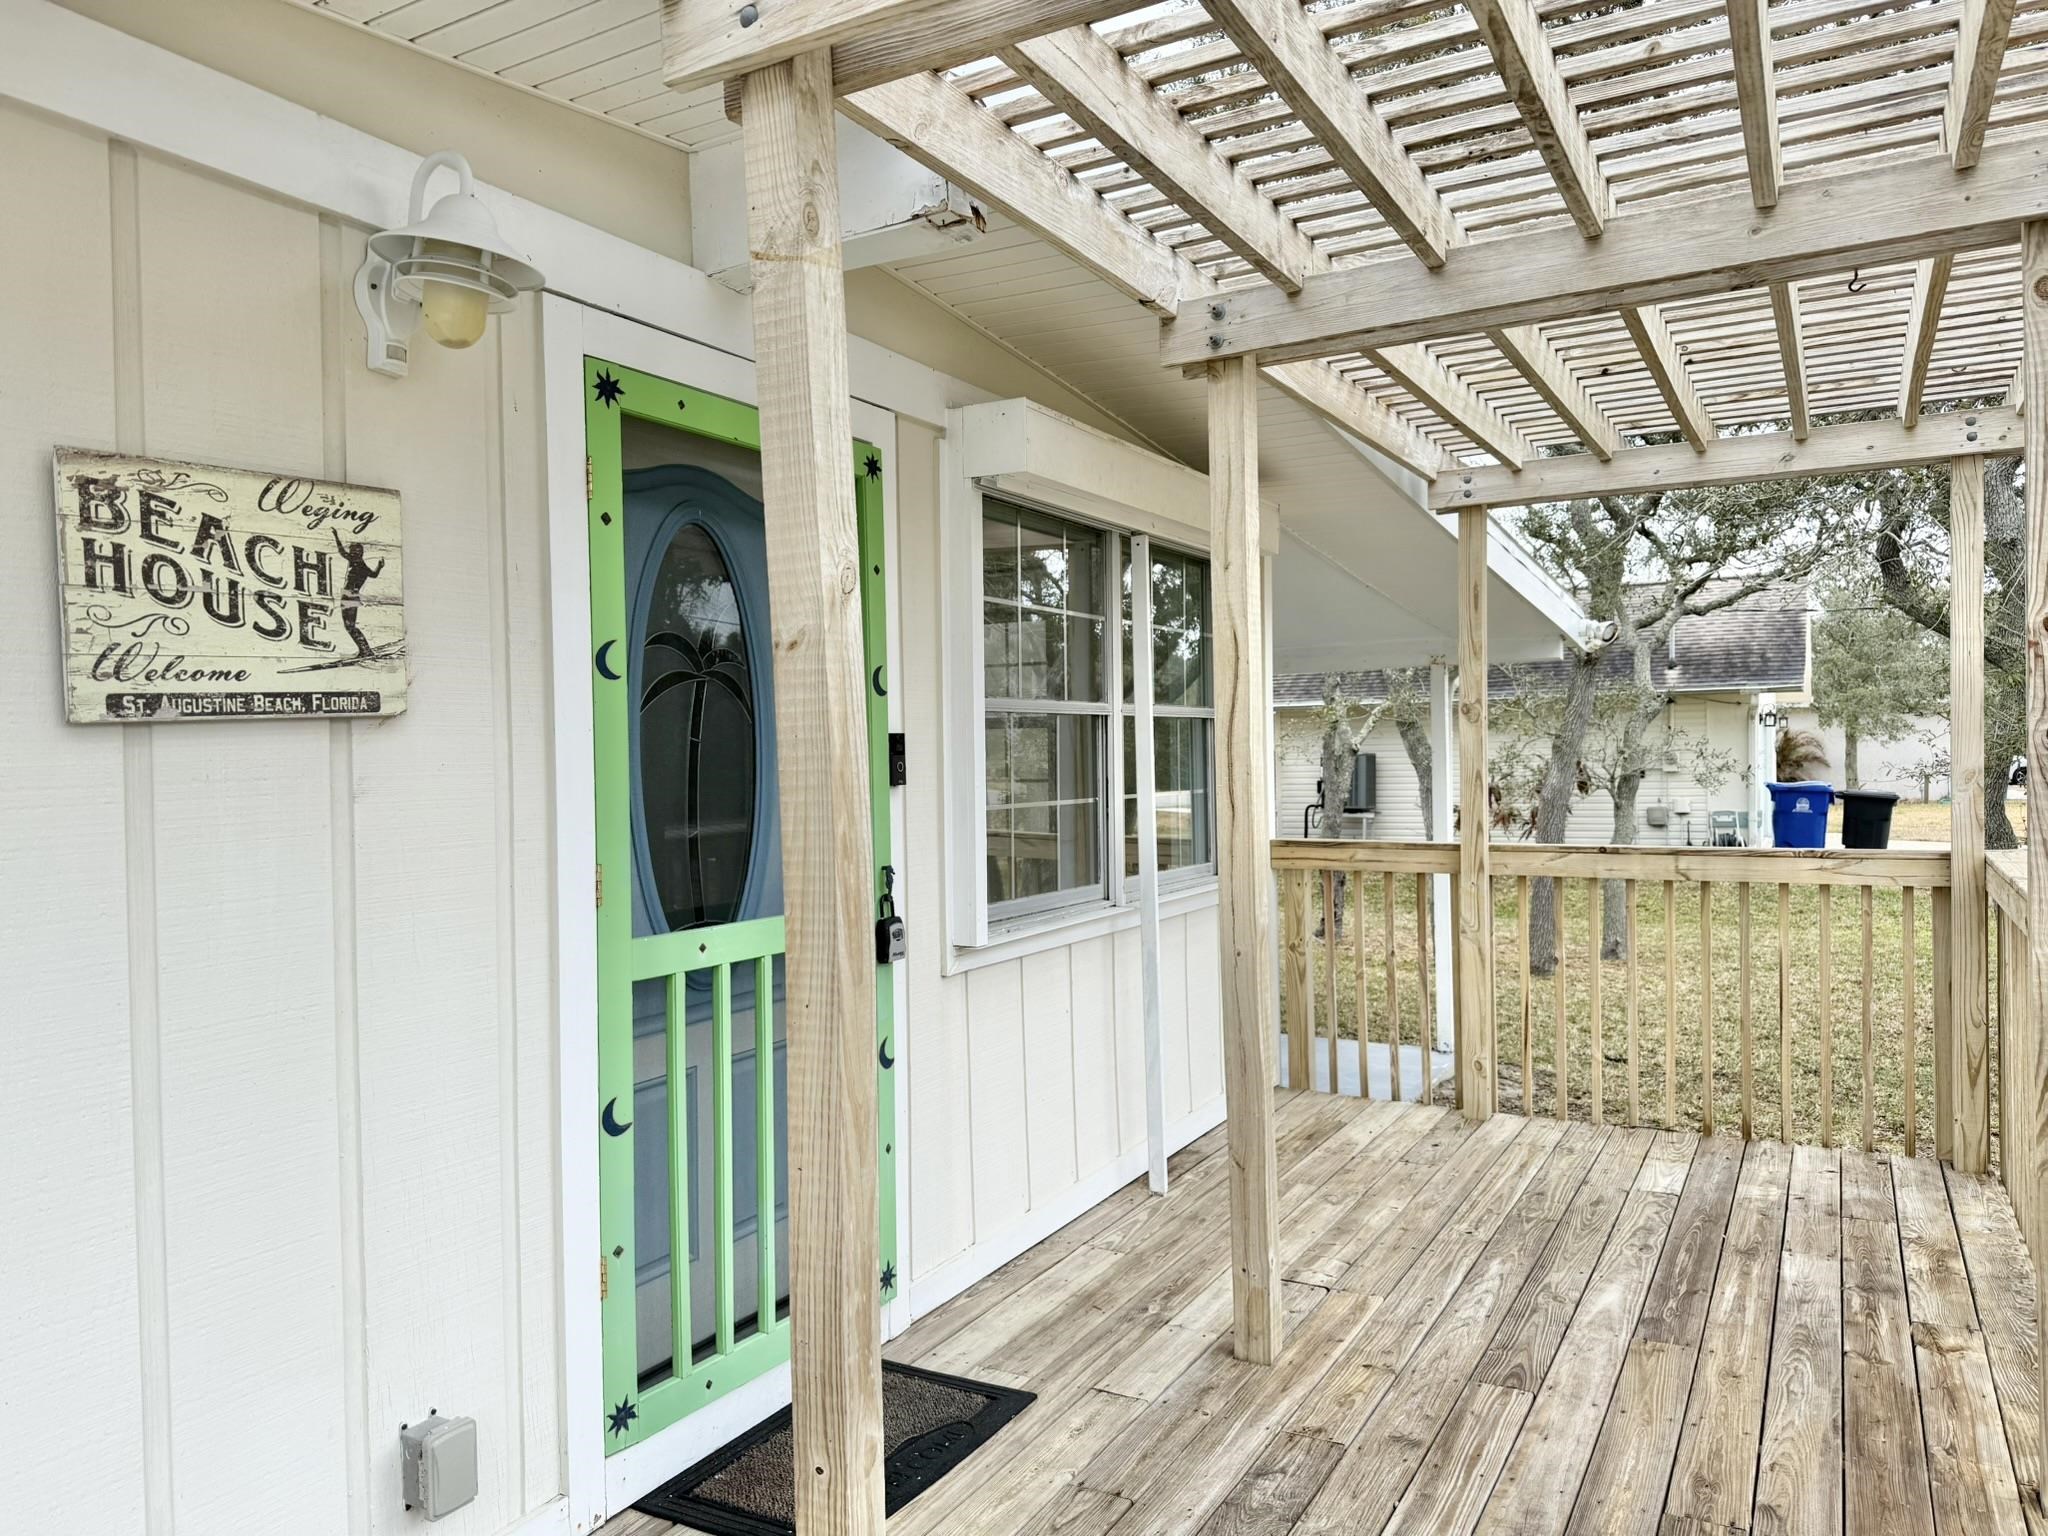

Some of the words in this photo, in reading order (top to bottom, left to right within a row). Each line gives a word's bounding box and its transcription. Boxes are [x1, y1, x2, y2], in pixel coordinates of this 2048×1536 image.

[258, 477, 379, 535] Weging
[78, 476, 335, 600] BEACH
[81, 537, 336, 652] HOUSE
[91, 641, 251, 682] Welcome
[160, 695, 246, 713] AUGUSTINE
[253, 693, 306, 712] BEACH,
[312, 693, 368, 711] FLORIDA
